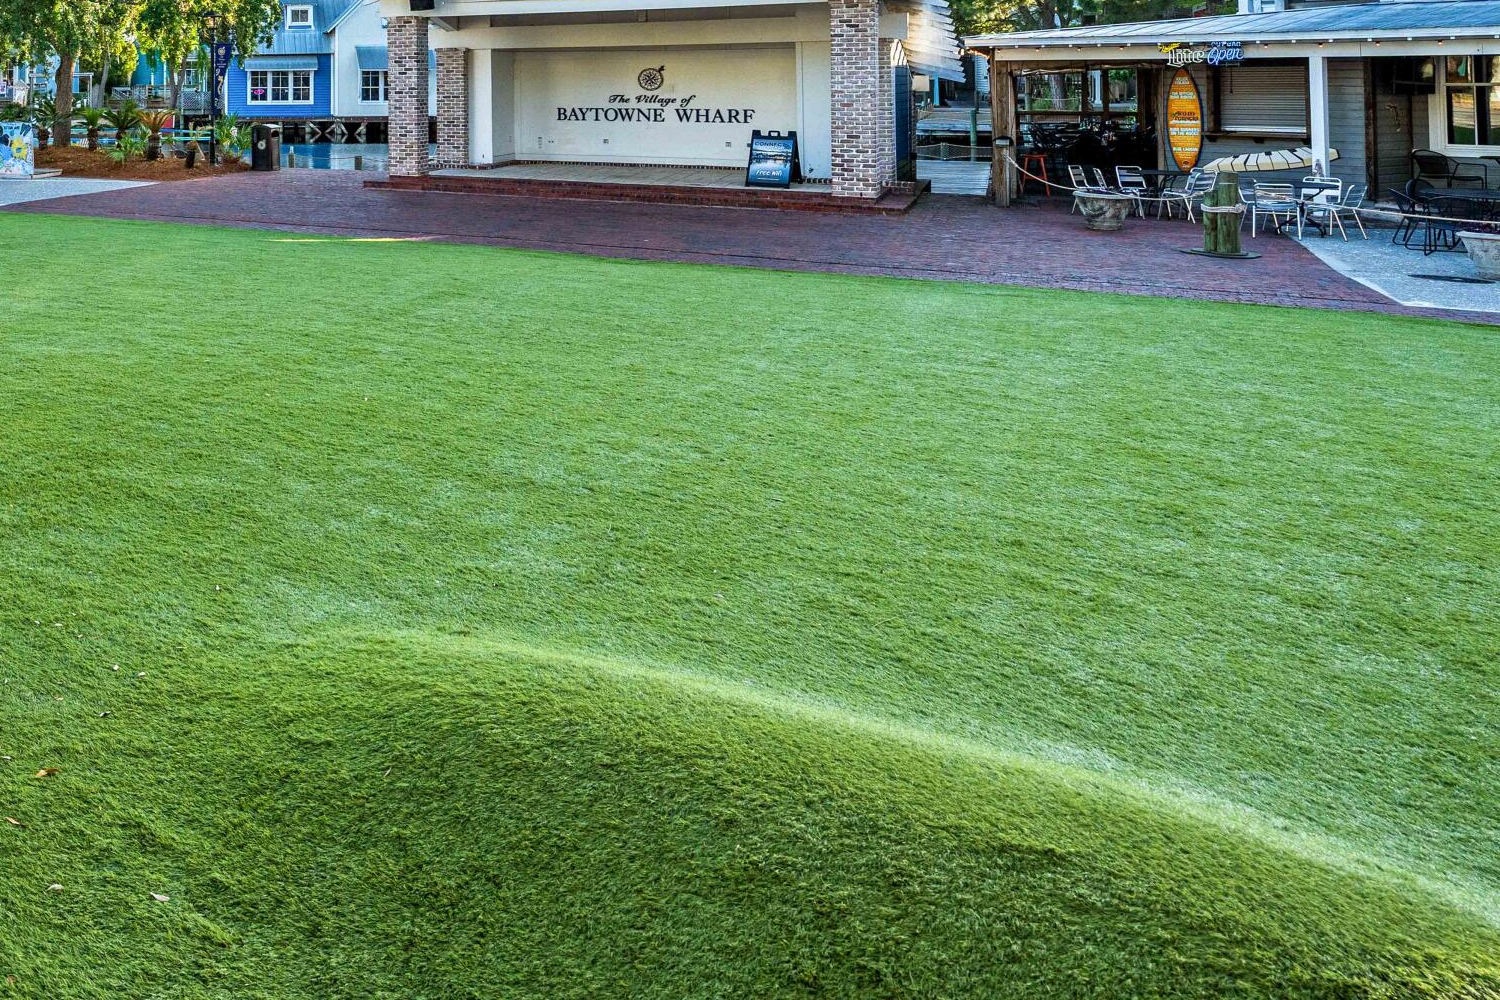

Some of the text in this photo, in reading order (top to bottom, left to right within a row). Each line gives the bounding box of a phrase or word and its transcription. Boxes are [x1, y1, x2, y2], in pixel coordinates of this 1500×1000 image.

[1166, 47, 1244, 67] Lite Open
[608, 94, 697, 107] The Village of
[556, 107, 756, 123] BAYTOWNE WHARF
